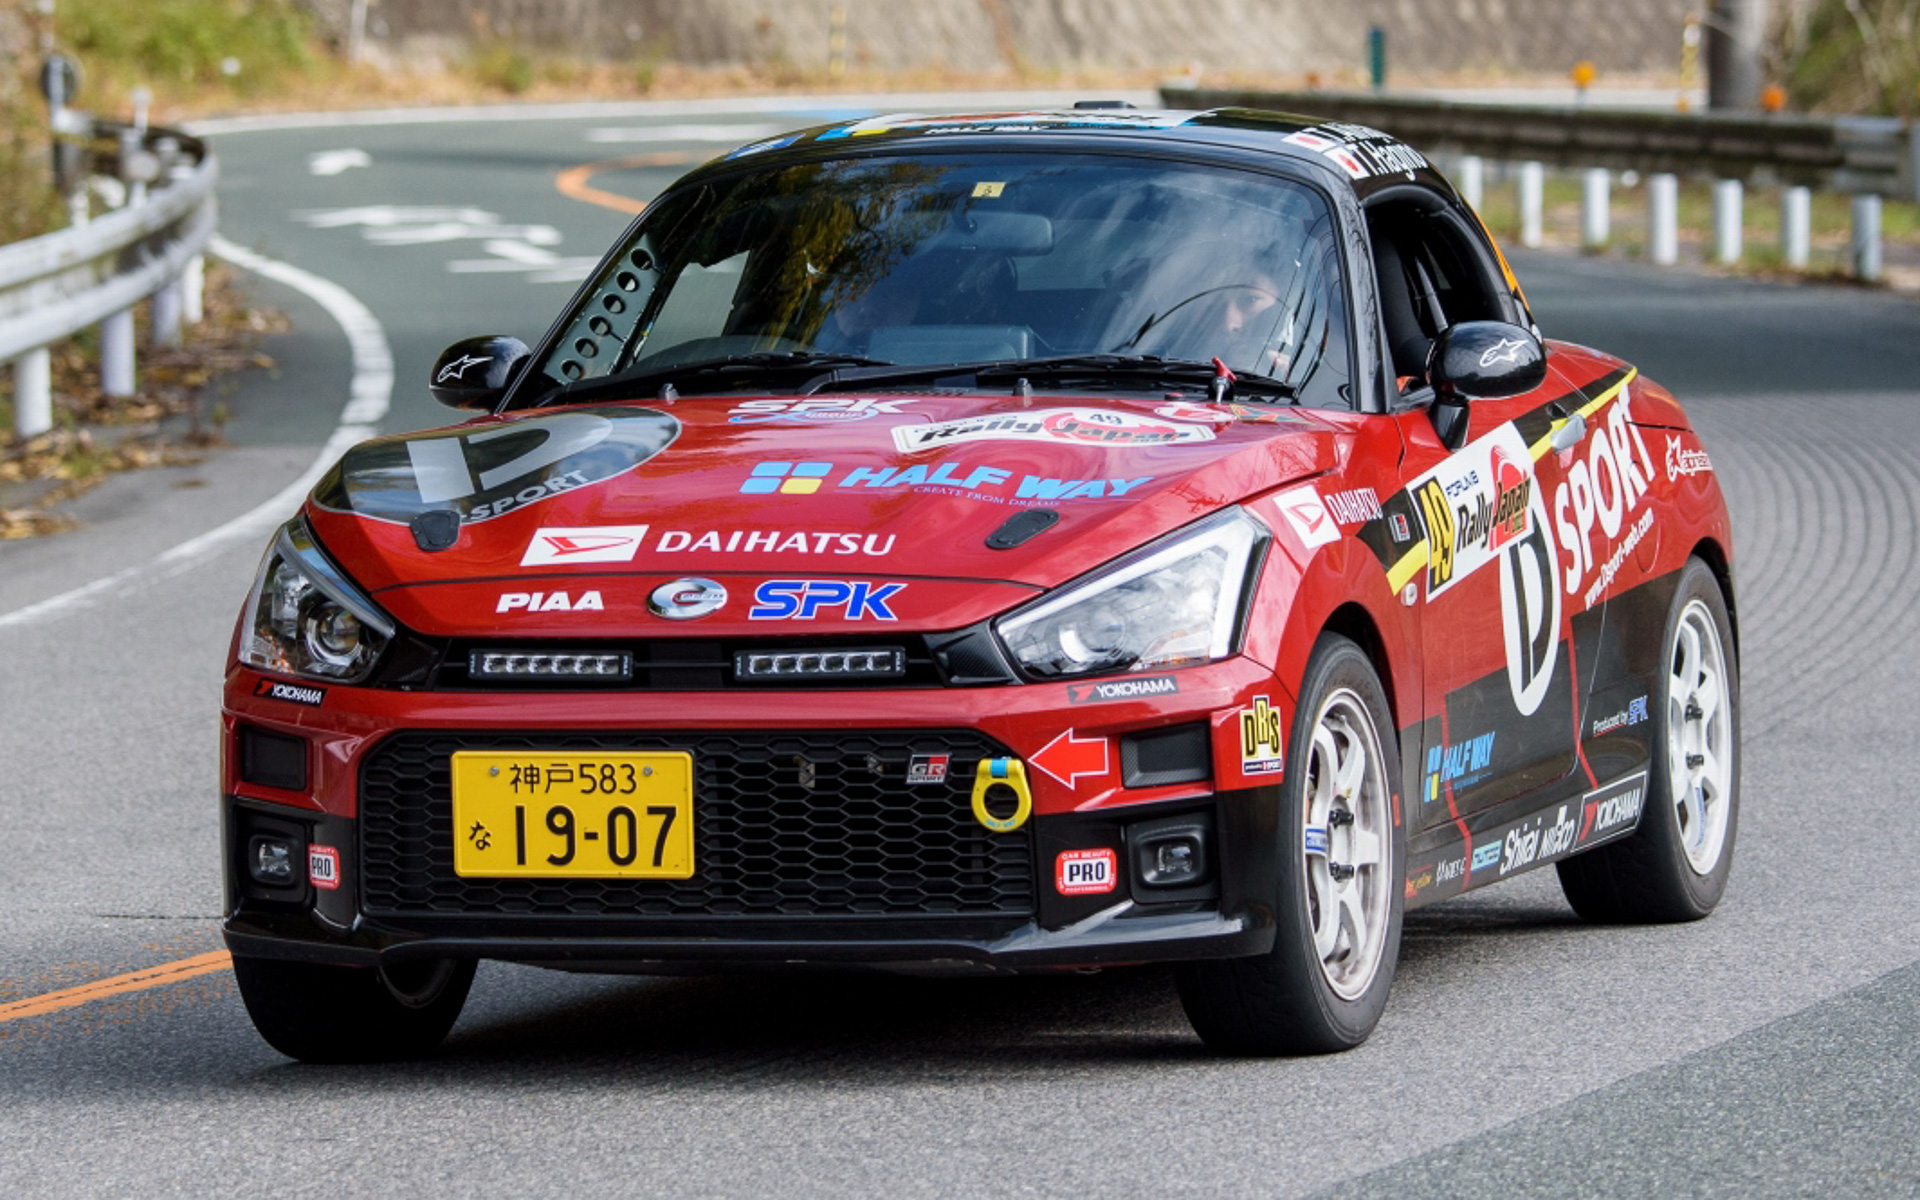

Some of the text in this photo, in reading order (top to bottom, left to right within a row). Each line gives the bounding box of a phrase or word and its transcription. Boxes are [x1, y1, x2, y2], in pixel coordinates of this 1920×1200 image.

[728, 398, 920, 414] SPK
[1089, 413, 1123, 425] 49
[918, 419, 1043, 443] Rally
[838, 461, 1154, 500] HALF WAY
[912, 485, 964, 497] CREATE
[1555, 381, 1656, 596] SPORT
[1324, 487, 1384, 526] DAIHATSU
[1455, 491, 1493, 555] Rally
[1491, 477, 1532, 535] Japan
[656, 530, 897, 556] DAIHATSU
[1419, 480, 1454, 586] 49
[495, 591, 605, 614] PIAA
[747, 579, 908, 622] SPK
[271, 683, 323, 704] YOKOHAMA
[1095, 678, 1176, 698] YOKOHAMA
[1593, 714, 1620, 735] Produced
[1439, 739, 1473, 784] HALF
[1470, 730, 1497, 773] WAY
[1594, 787, 1642, 832] YOKOHAMA
[469, 804, 677, 867] な 19-07
[1068, 861, 1105, 882] PRO
